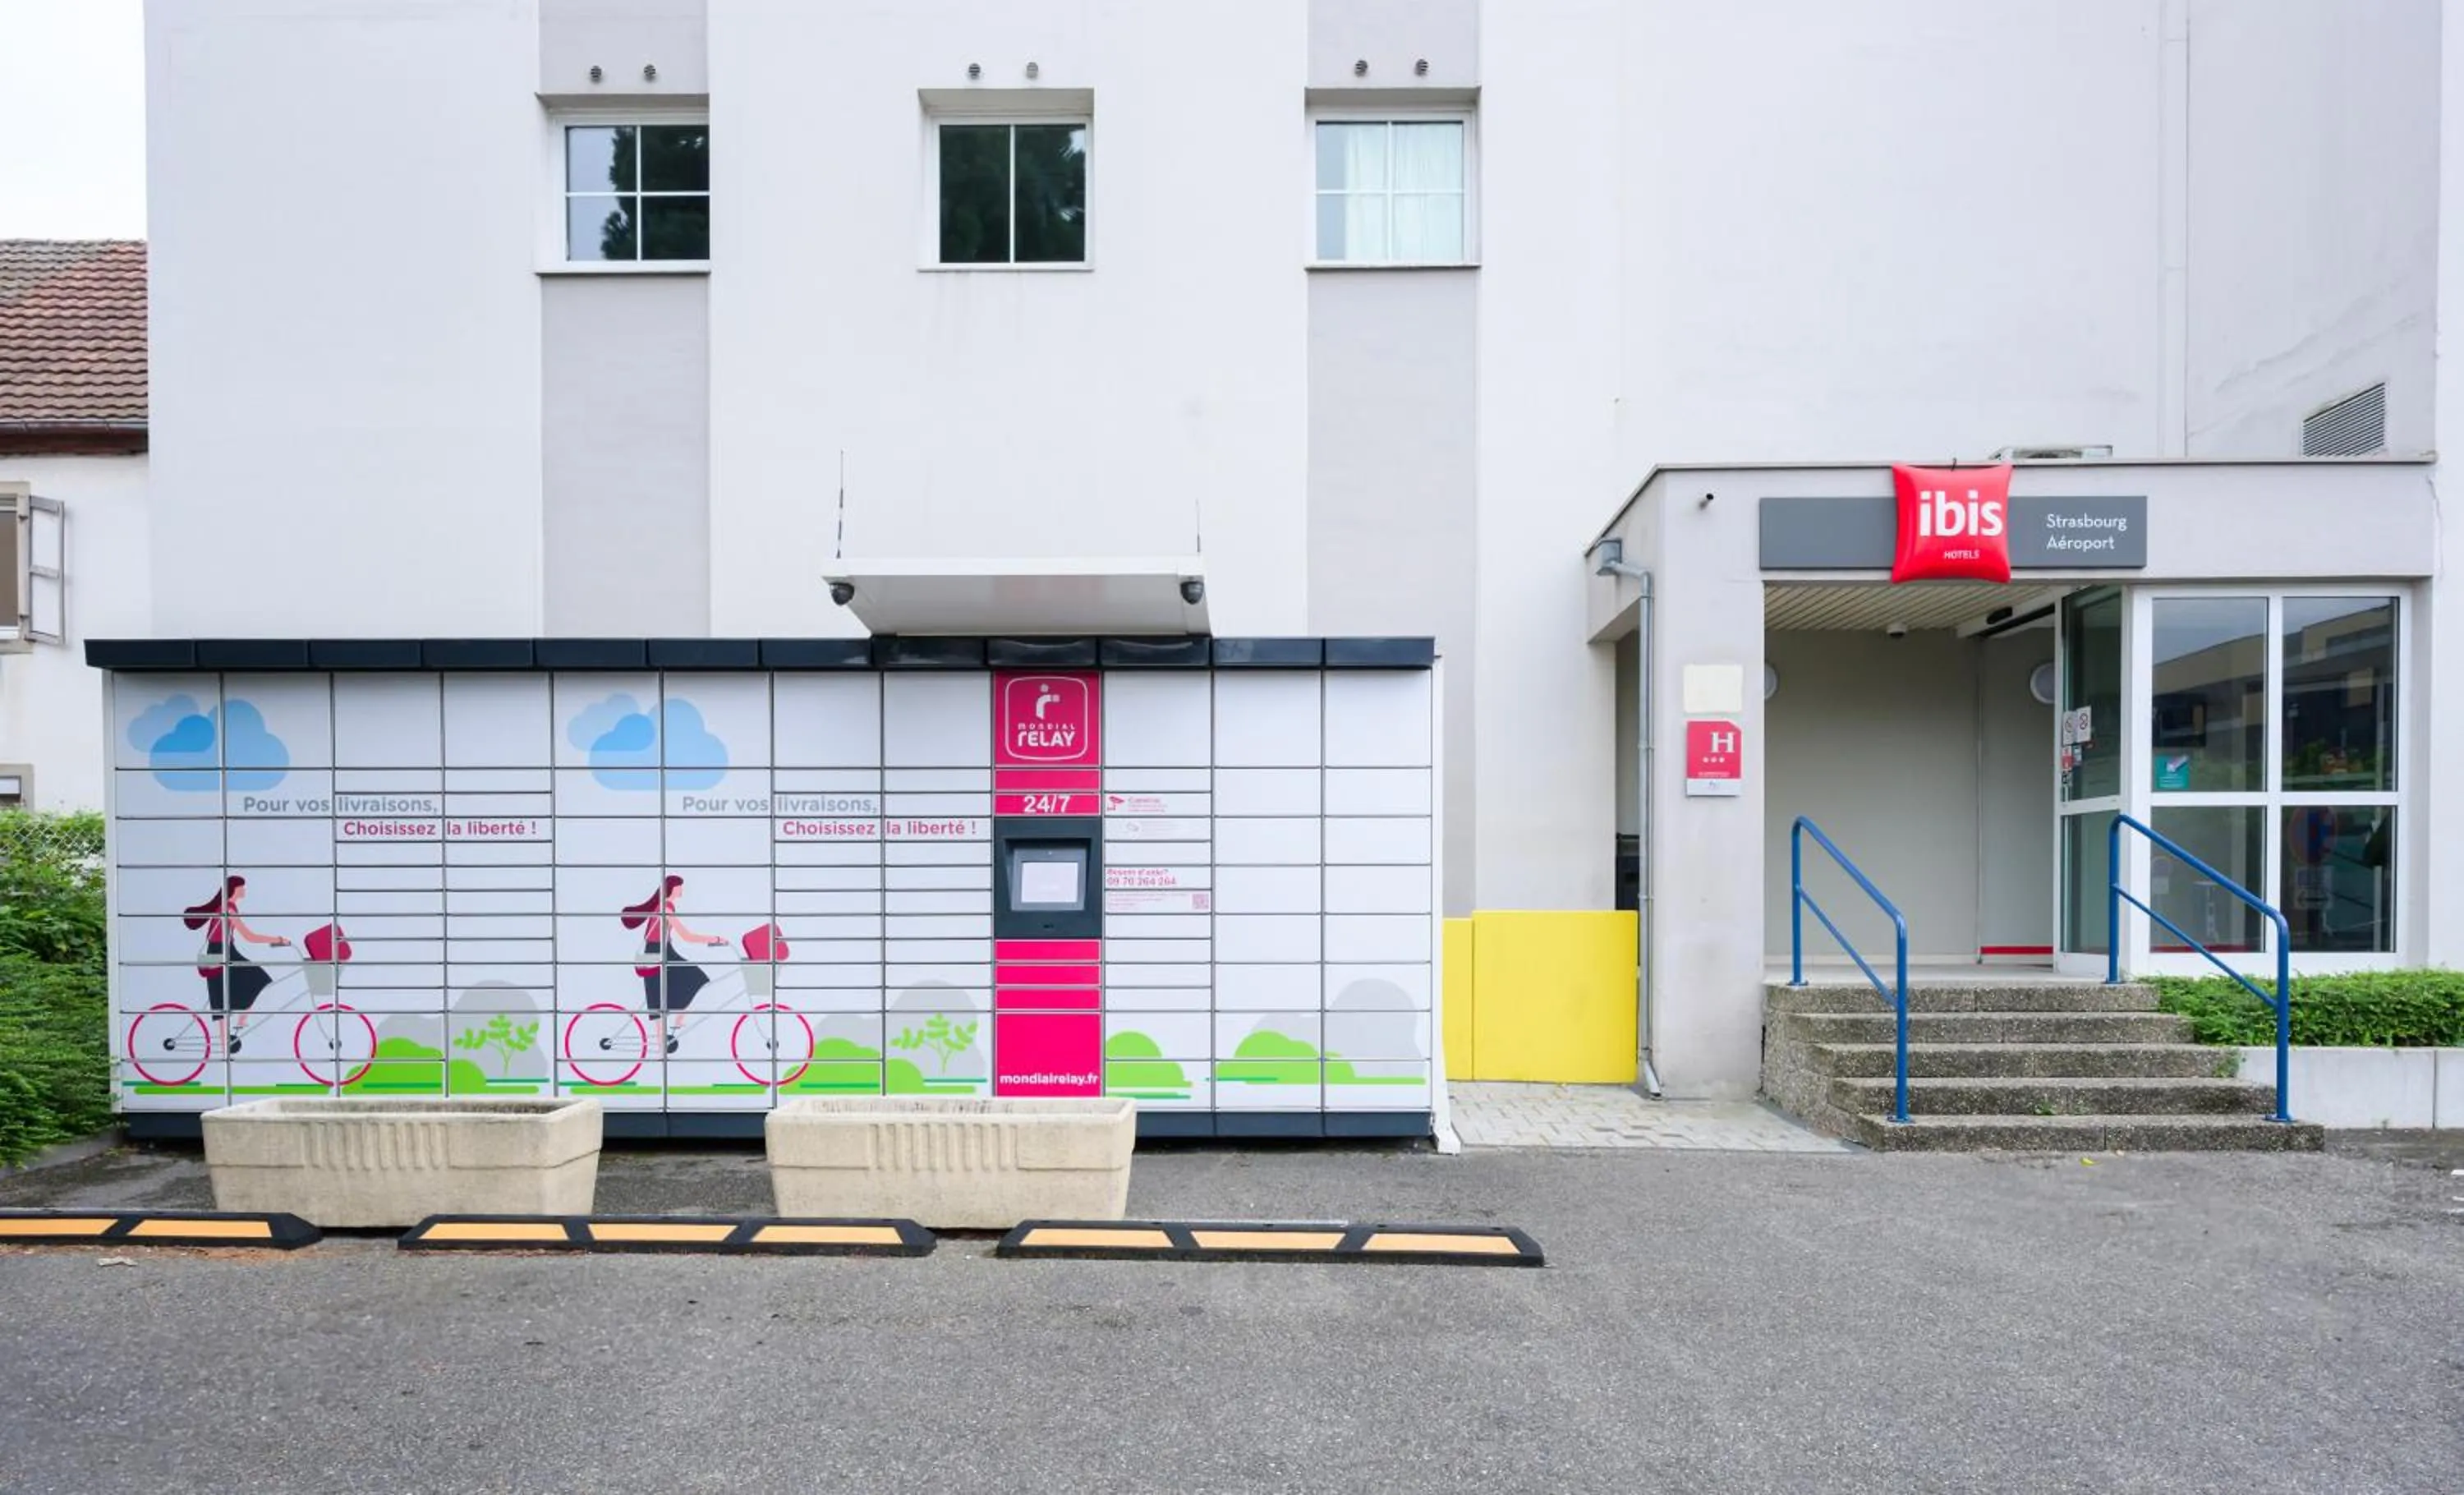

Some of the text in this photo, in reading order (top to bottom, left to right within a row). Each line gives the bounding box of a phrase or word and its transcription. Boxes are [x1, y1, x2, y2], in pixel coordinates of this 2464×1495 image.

[1919, 490, 2003, 536] ibis
[2046, 513, 2127, 531] Strasbourg
[2046, 533, 2115, 552] Aéroport
[1943, 549, 1980, 559] HOTELS
[1710, 732, 1735, 753] H
[243, 796, 438, 815] Pour vos livraisons,
[682, 796, 879, 814] Pour vos livraisons,
[1023, 794, 1071, 814] 24/7
[343, 821, 436, 835] Choisissez
[446, 821, 462, 835] la
[467, 821, 526, 835] liberté
[783, 821, 876, 835] Choisissez
[886, 821, 901, 835] la
[908, 821, 966, 835] liberté
[1106, 876, 1119, 886] 09
[1123, 876, 1134, 886] 70
[999, 1072, 1099, 1086] mondialrelay.fr
